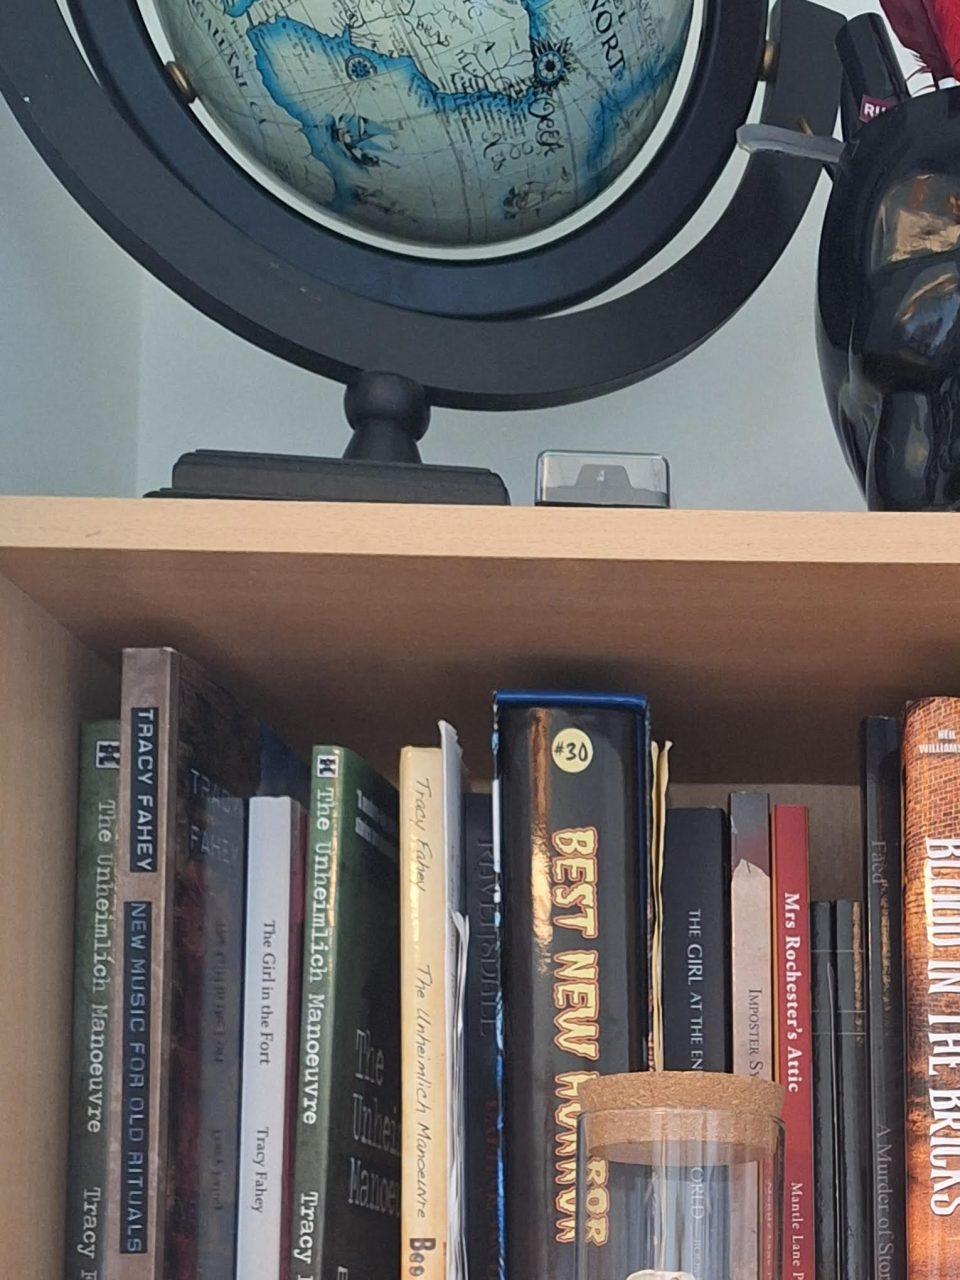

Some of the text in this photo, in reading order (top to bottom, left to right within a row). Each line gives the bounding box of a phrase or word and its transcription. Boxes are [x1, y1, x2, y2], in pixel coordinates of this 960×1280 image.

[136, 708, 154, 871] TRACY FAHEY
[316, 787, 334, 831] The
[93, 853, 115, 993] Unheimlich
[308, 841, 332, 984] Unheimlich
[552, 826, 600, 1060] BEST NEW
[686, 942, 703, 985] GIRL
[302, 993, 325, 1125] Manoeuvre
[411, 777, 433, 1219] Tracy Unheimlich Manoeuvre
[748, 988, 763, 1056] IMPOSTER
[783, 892, 803, 1229] Mrs Rochester's Attic Mantle
[87, 1003, 109, 1133] Manoeuvre
[127, 902, 147, 1253] NEW MUSIC FOR OLD RITUALS
[254, 1127, 270, 1168] Tracy
[77, 1187, 101, 1259] Tracy
[295, 1190, 318, 1264] Tracy
